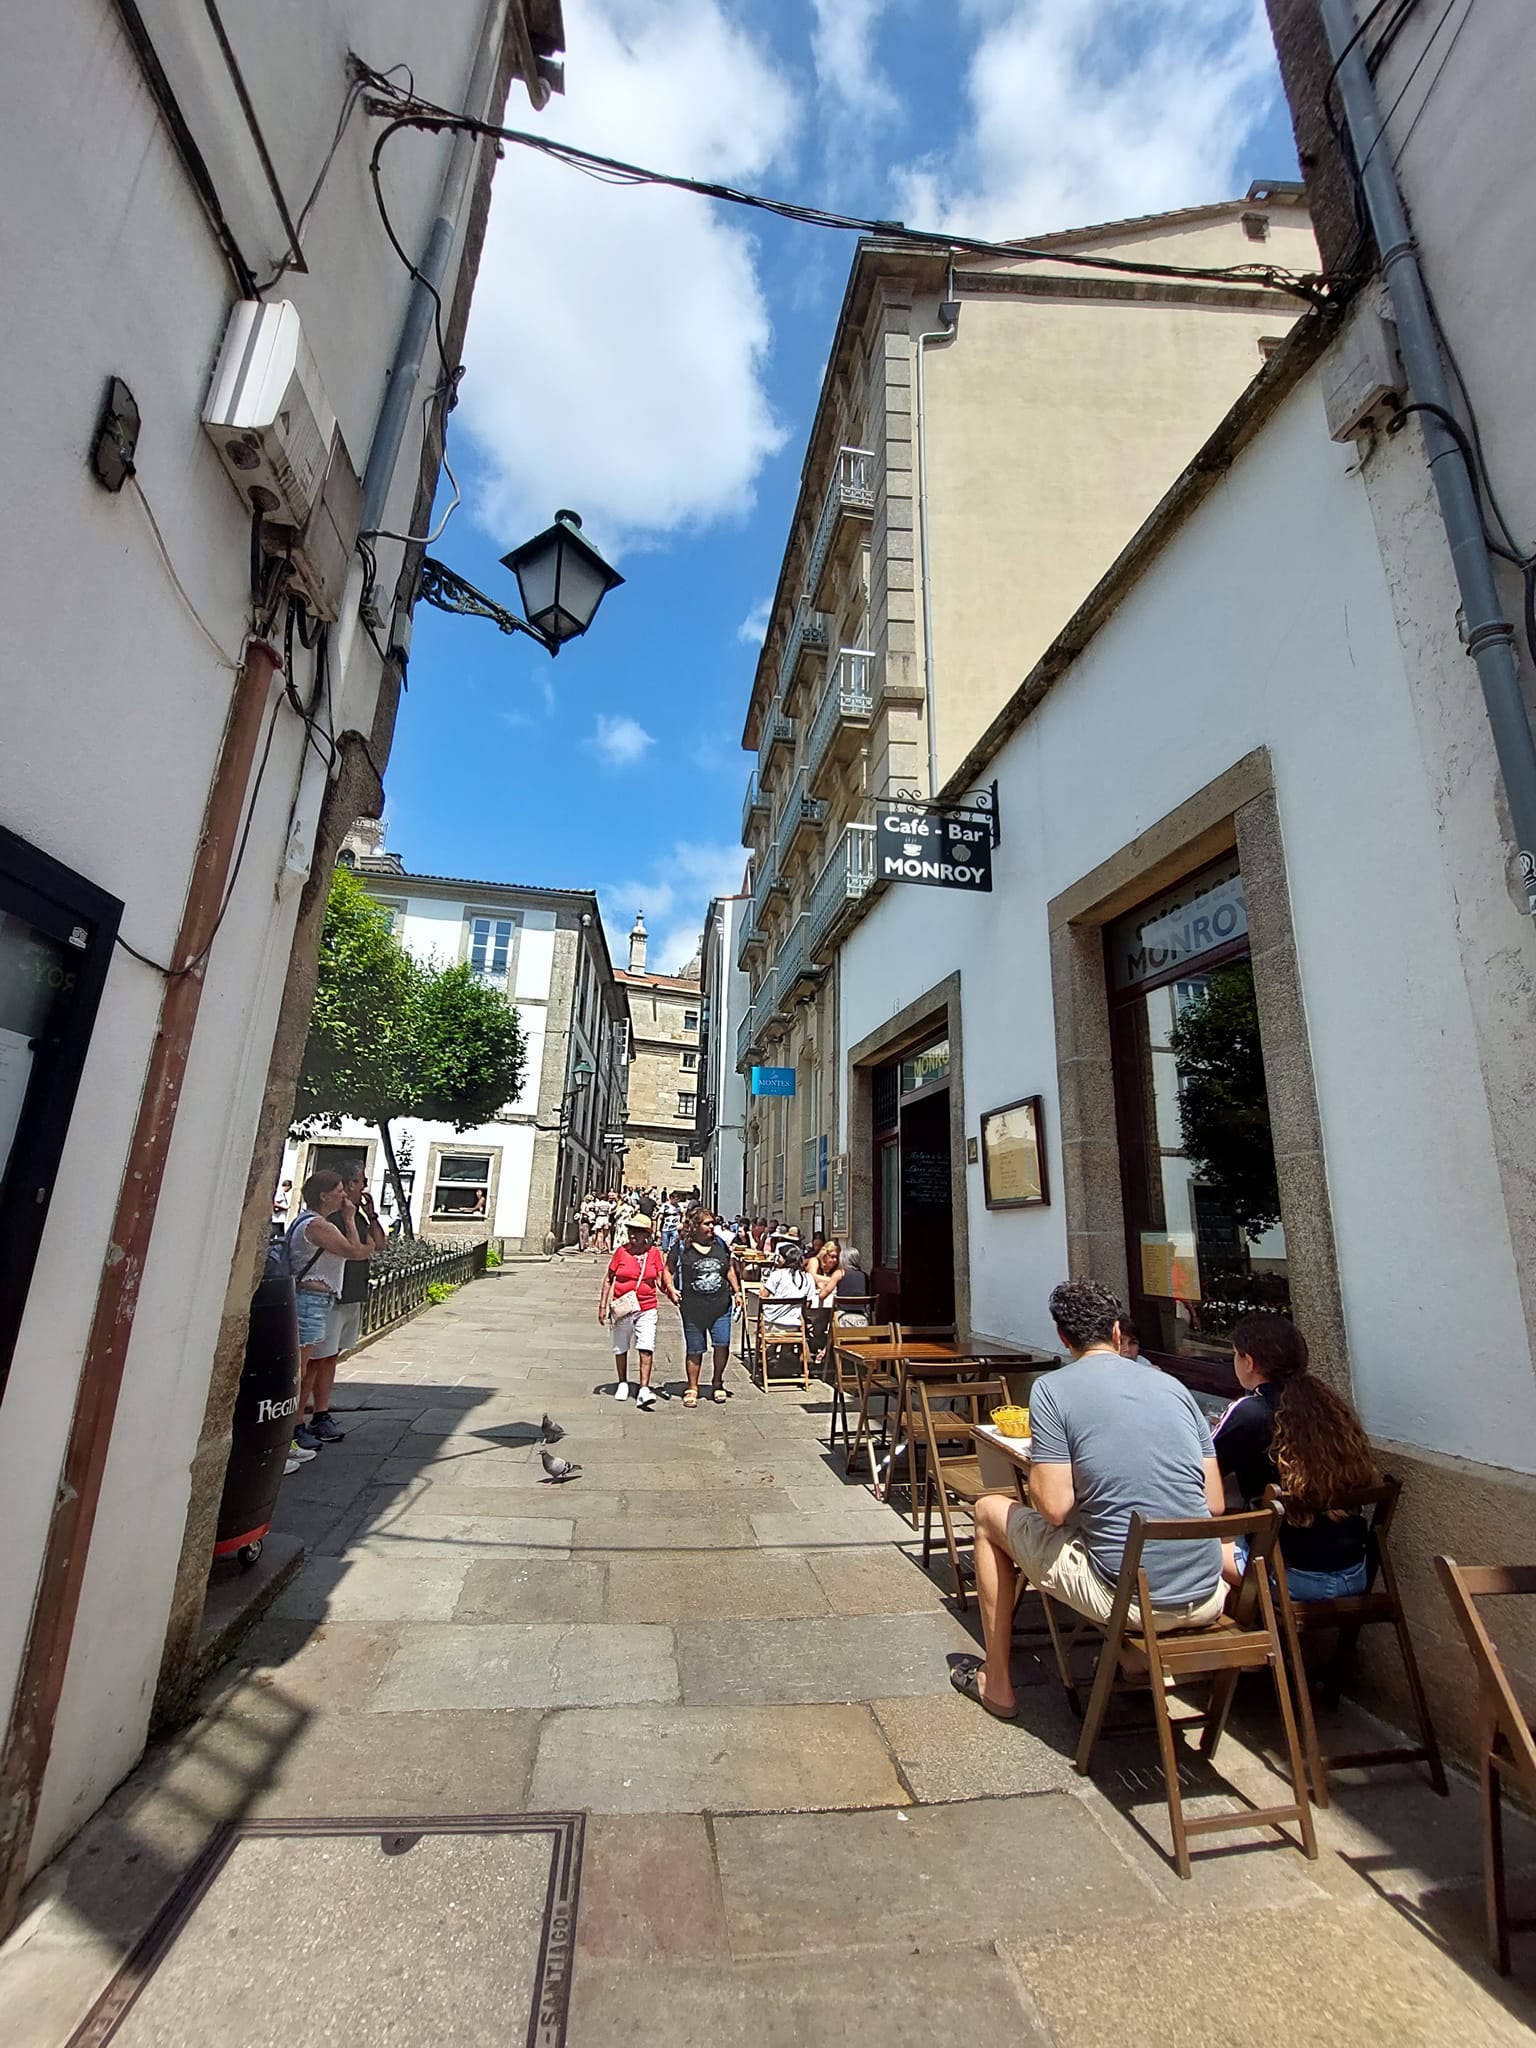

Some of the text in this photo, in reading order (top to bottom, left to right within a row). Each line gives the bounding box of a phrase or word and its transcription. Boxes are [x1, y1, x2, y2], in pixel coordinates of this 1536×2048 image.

[884, 816, 929, 836] Café
[948, 824, 983, 842] Bar
[884, 857, 985, 884] MONROY
[758, 1079, 791, 1087] MONTES
